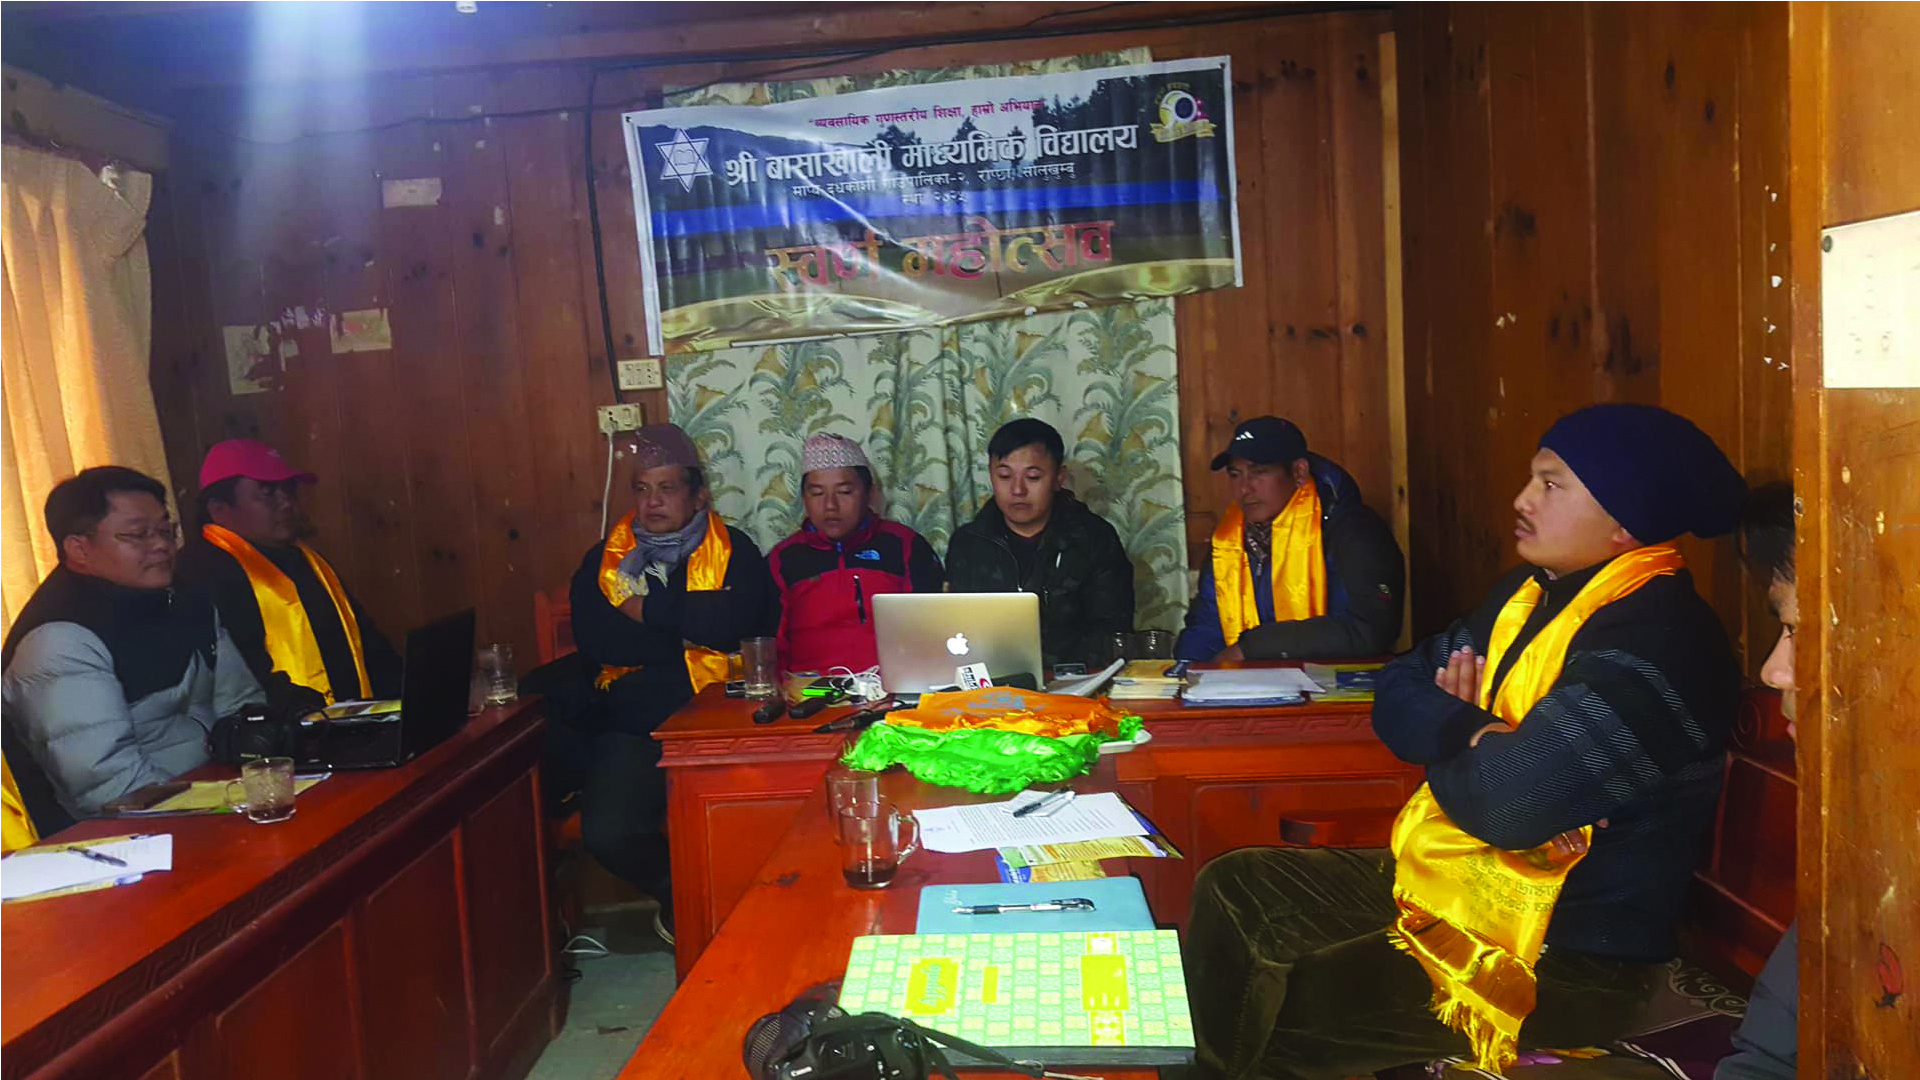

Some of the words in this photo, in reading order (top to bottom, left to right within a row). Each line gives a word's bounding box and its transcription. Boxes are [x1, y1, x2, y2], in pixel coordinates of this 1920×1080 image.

[724, 151, 758, 186] श्री
[766, 140, 893, 181] बासाखाली
[902, 131, 1026, 168] माध्यमिक
[1035, 124, 1139, 158] विद्यालय
[764, 229, 882, 291] स्वर्ण
[901, 216, 1115, 280] महोत्सव
